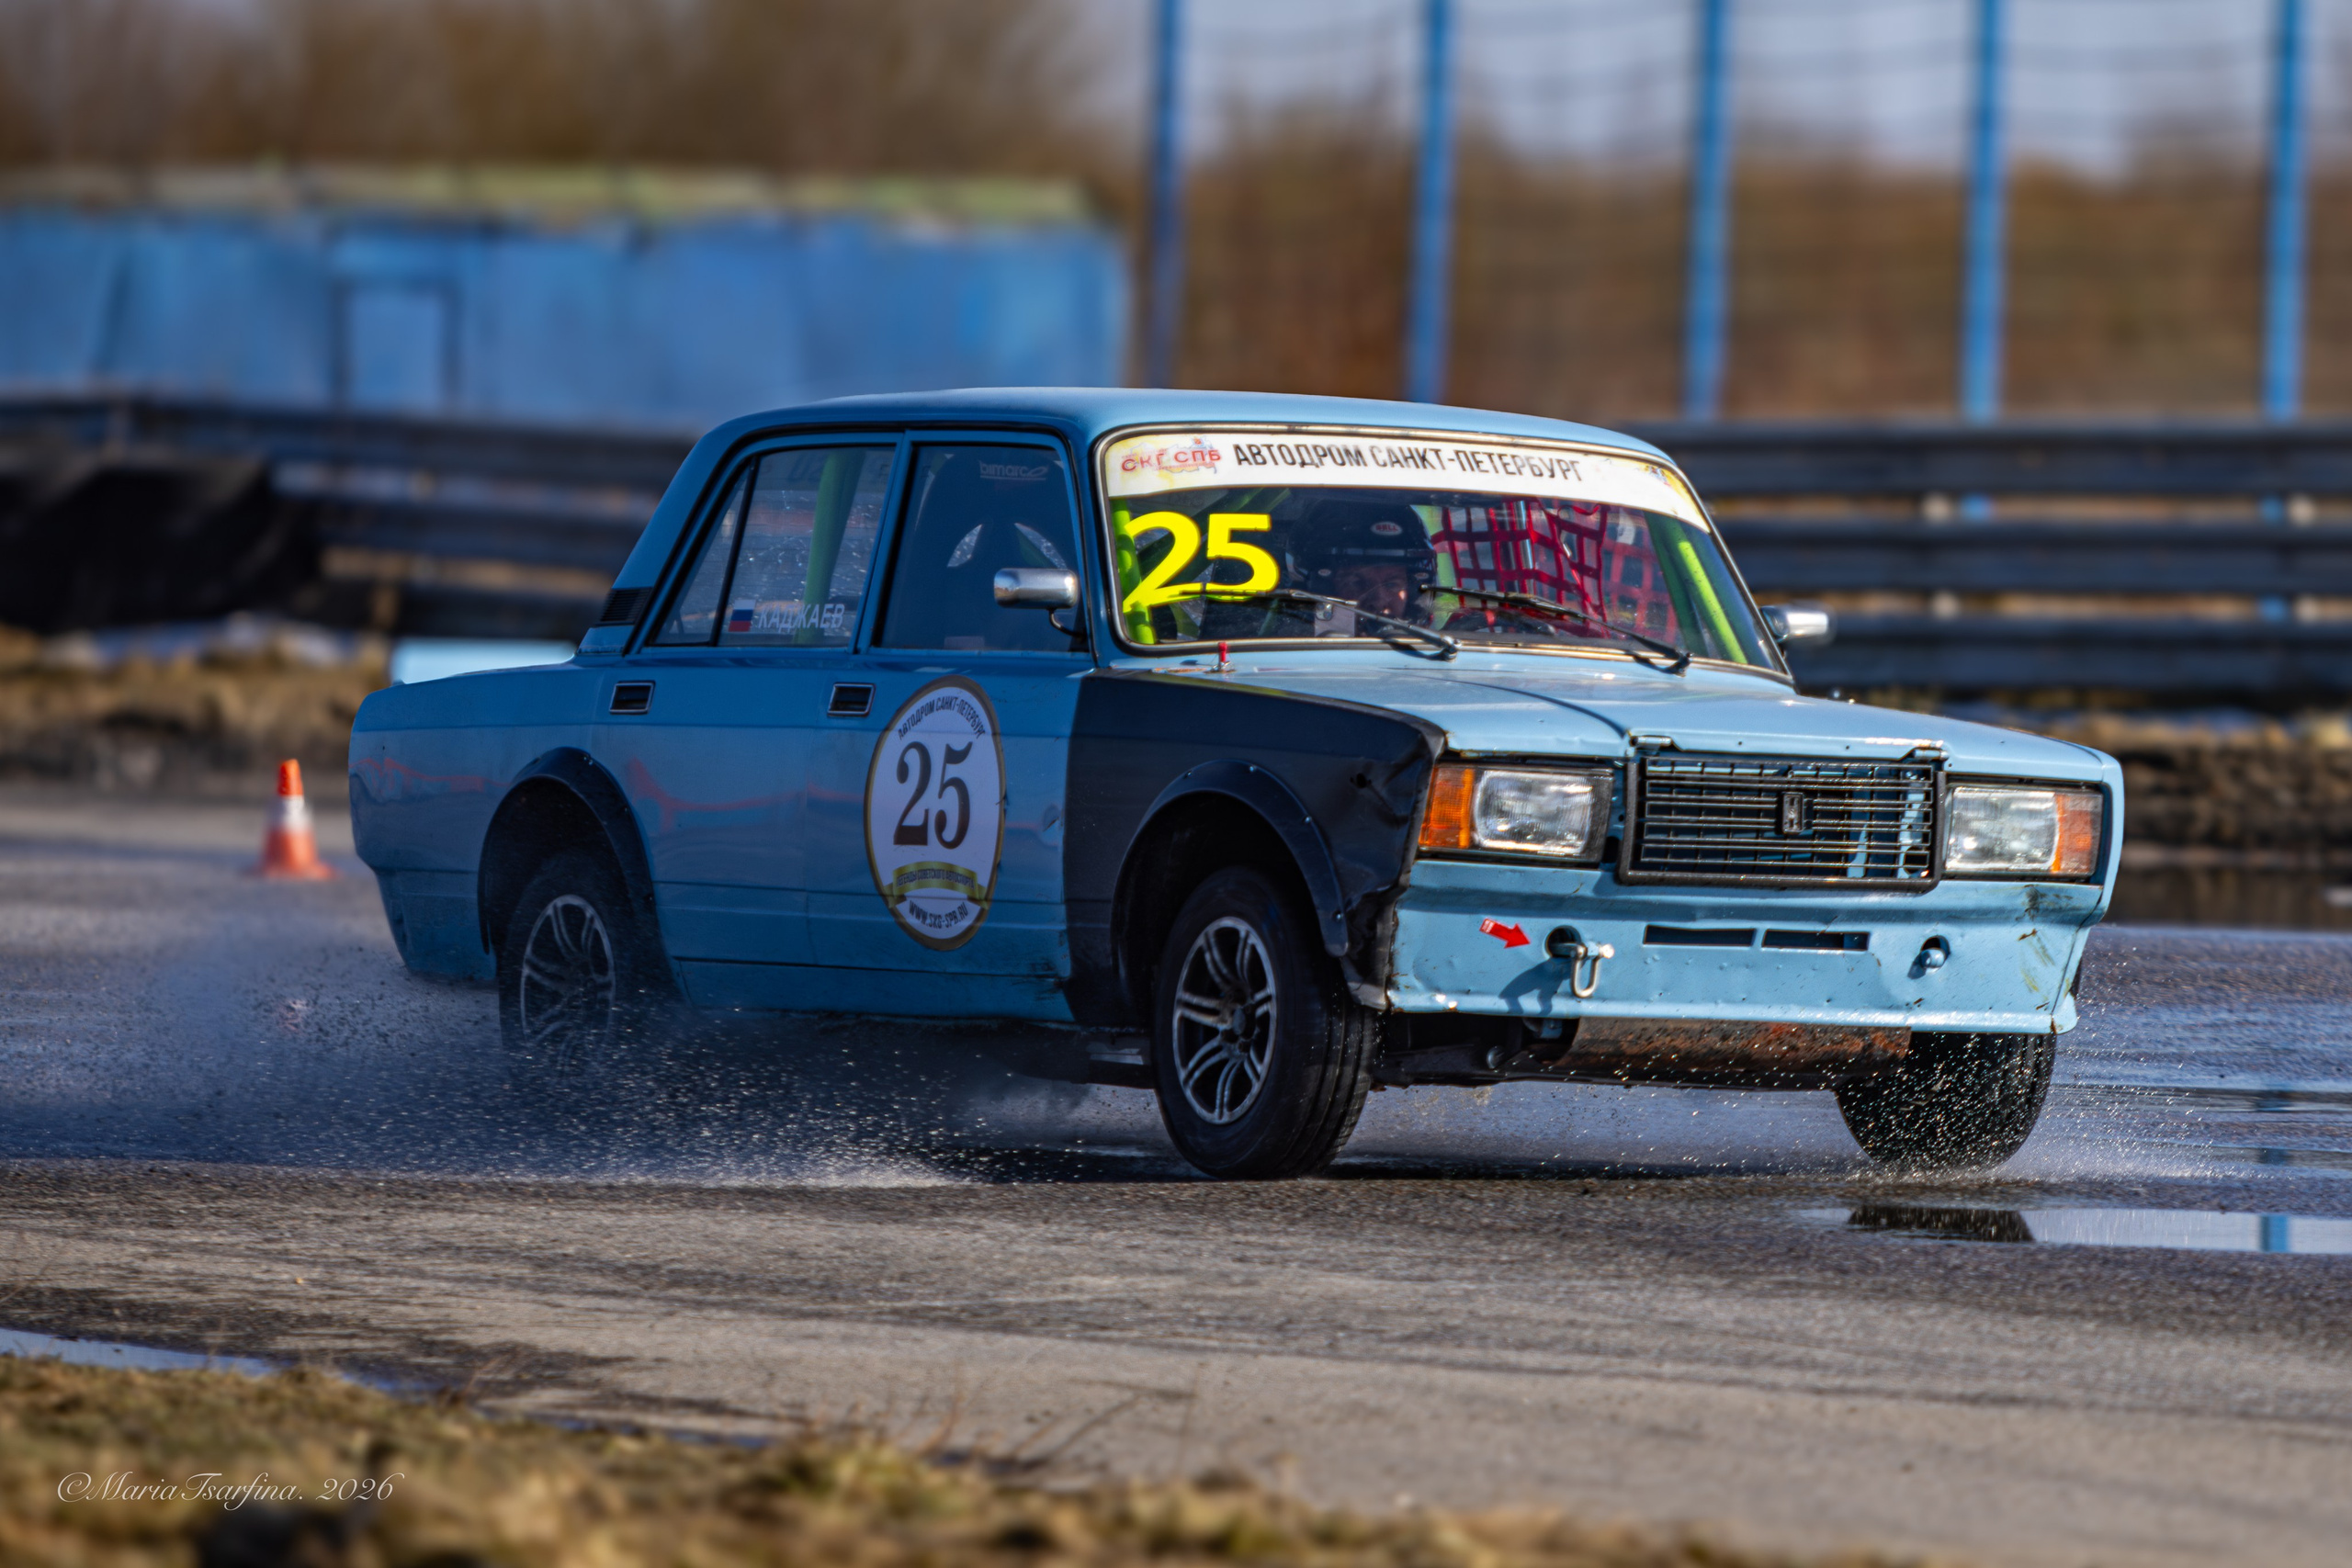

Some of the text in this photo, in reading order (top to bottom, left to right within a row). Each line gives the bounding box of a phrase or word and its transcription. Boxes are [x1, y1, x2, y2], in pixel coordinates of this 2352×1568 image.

[978, 460, 1049, 478] bimarco
[1121, 449, 1222, 472] СКГ СПБ
[1232, 443, 1583, 482] АВТОДРОМ САНКТ-ПЕТЕРБУРГ
[1122, 511, 1280, 613] 25
[758, 603, 845, 634] КАДЖАЕВ
[898, 695, 986, 740] АВТОДРОМ САНКТ-ПЕТЕРБУРГ
[893, 740, 973, 850] 25
[909, 900, 969, 929] WWW.SKG-SPB.RU
